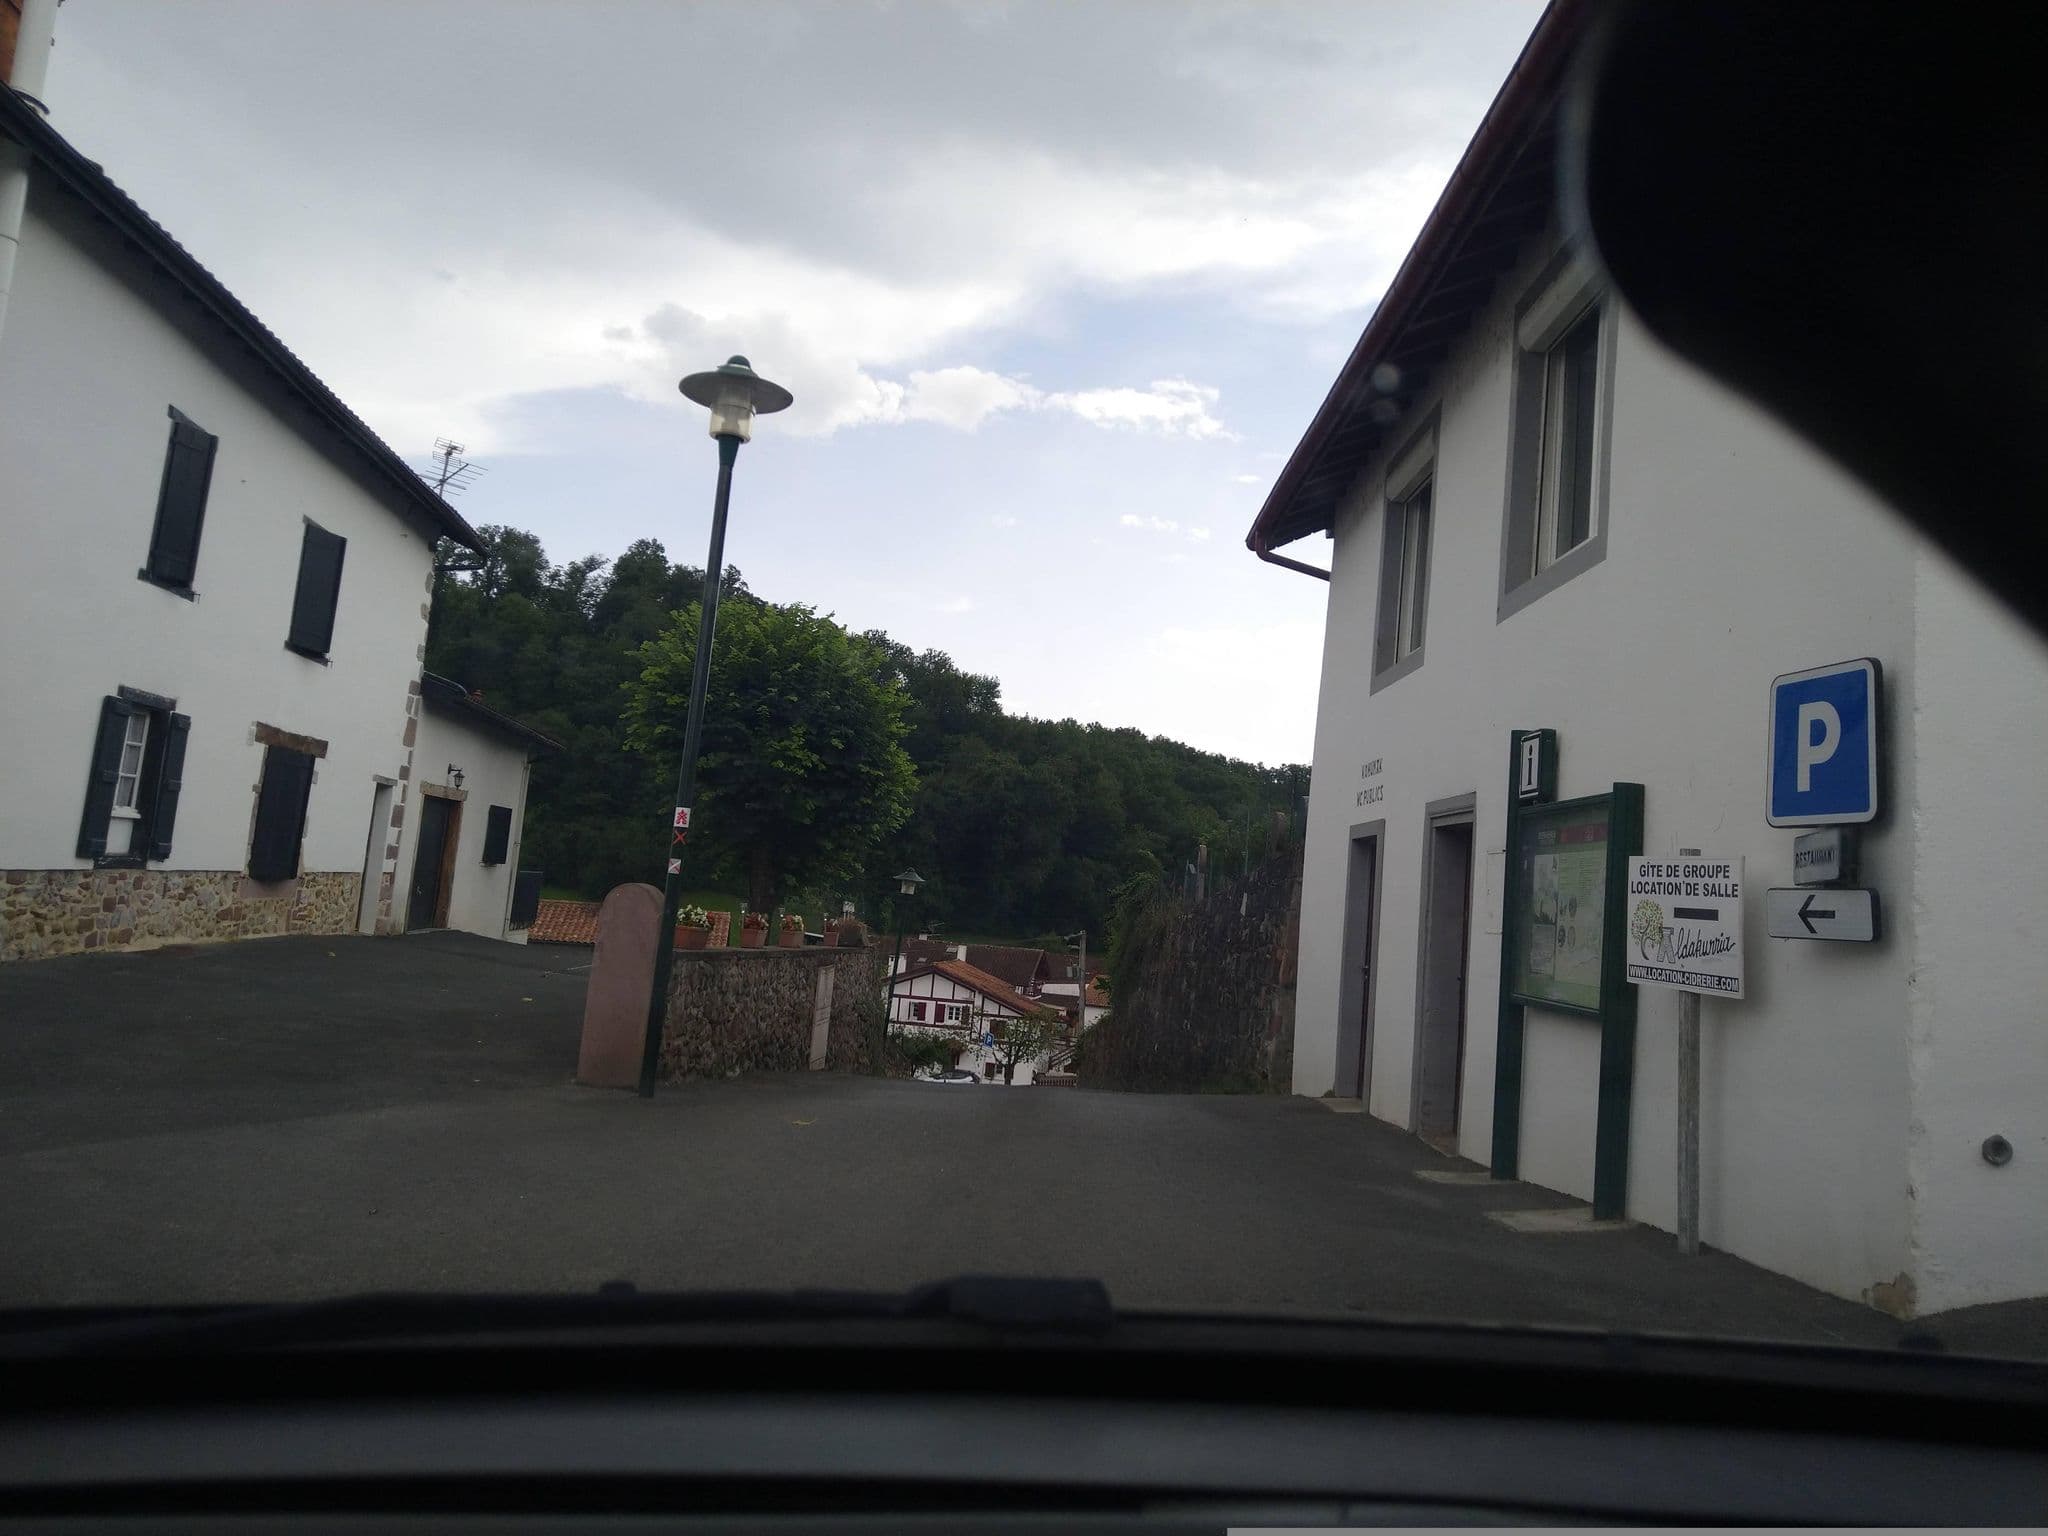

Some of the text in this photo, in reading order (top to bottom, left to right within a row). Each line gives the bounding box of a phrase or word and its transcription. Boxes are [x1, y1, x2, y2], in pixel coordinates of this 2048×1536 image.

[1797, 700, 1842, 793] P
[1639, 861, 1730, 879] GÎTE DE GROUPE
[1631, 880, 1739, 898] LOCATION DE SALLE
[1629, 964, 1739, 992] WWW.LOCATION-CIDRERIE.COM
